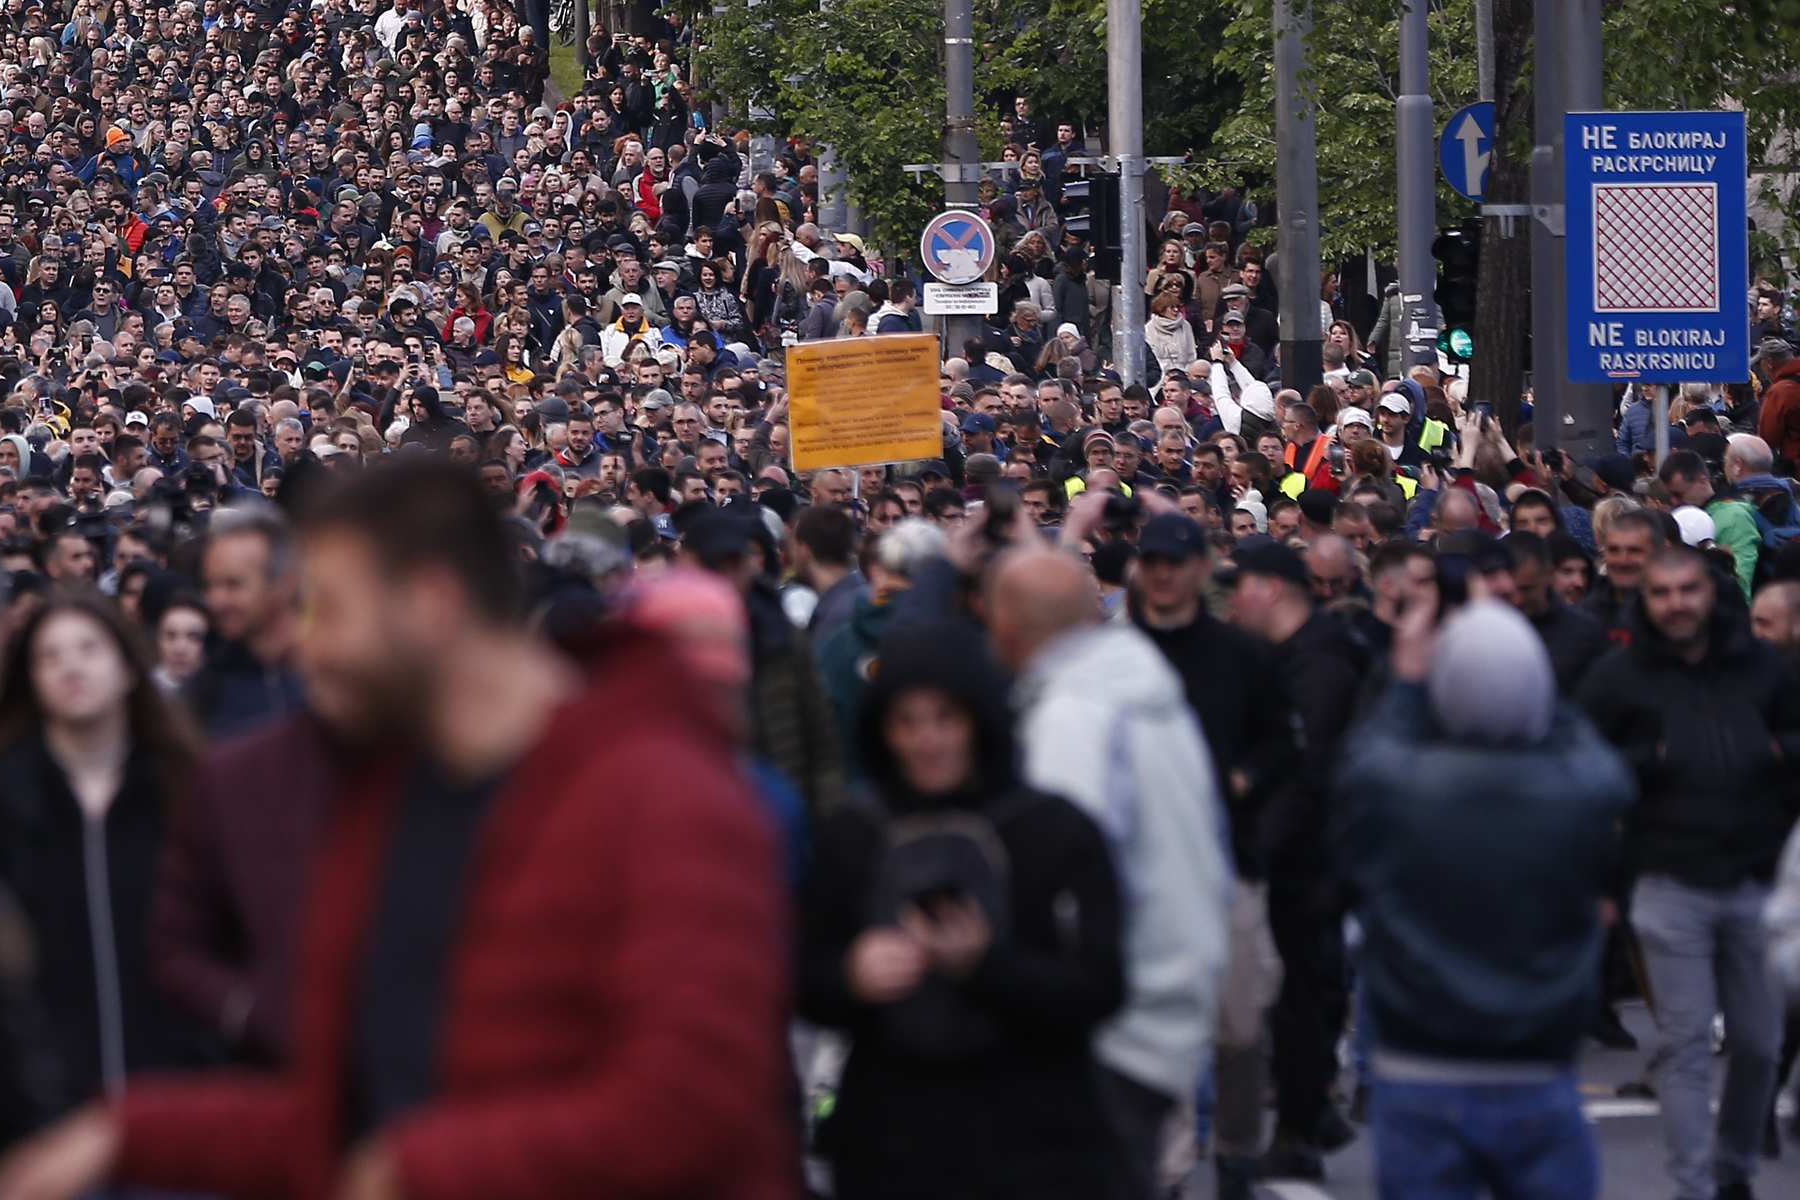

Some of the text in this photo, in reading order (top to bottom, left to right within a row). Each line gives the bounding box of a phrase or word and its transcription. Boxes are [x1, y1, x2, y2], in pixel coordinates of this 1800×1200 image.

[1582, 124, 1727, 150] НЕ БЛОКИРАЈ
[1591, 154, 1717, 175] РАСКРСНИЦУ
[1589, 322, 1725, 347] NE BLOKIRAJ
[1600, 352, 1716, 370] RASKRSNICU
